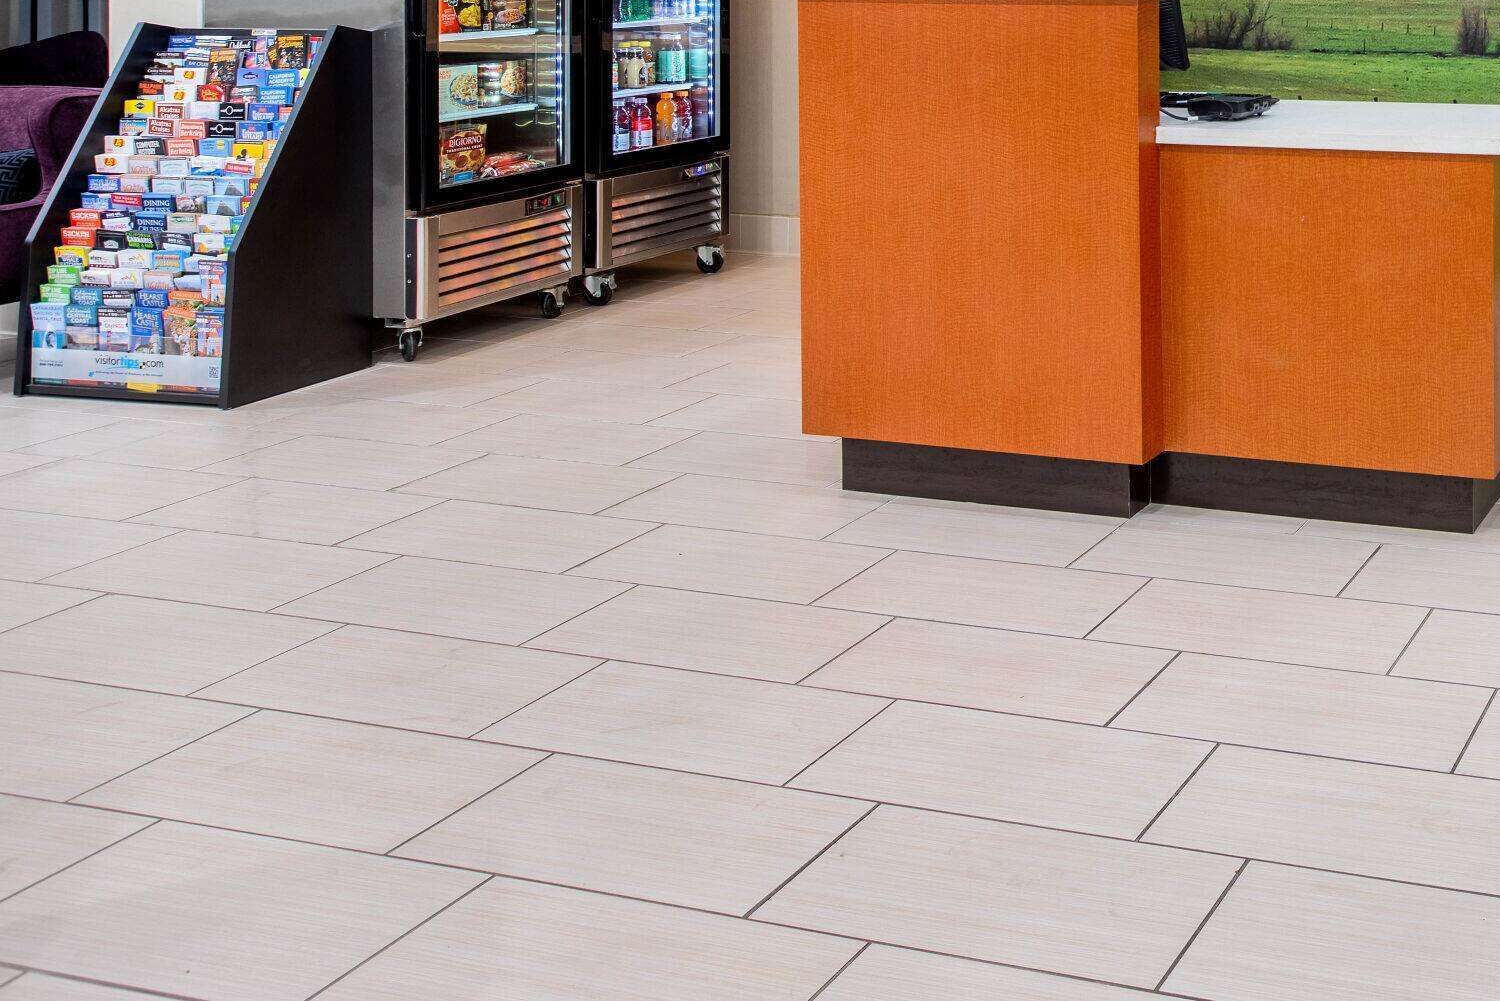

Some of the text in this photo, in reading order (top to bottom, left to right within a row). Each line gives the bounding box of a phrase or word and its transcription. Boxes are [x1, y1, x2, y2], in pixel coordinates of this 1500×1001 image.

[450, 135, 482, 147] DIGIORNO
[140, 292, 164, 300] HEARST
[142, 299, 165, 307] CASTLE
[136, 309, 158, 321] HEARST
[136, 317, 159, 328] CASTLE
[95, 355, 164, 370] visitortips.com
